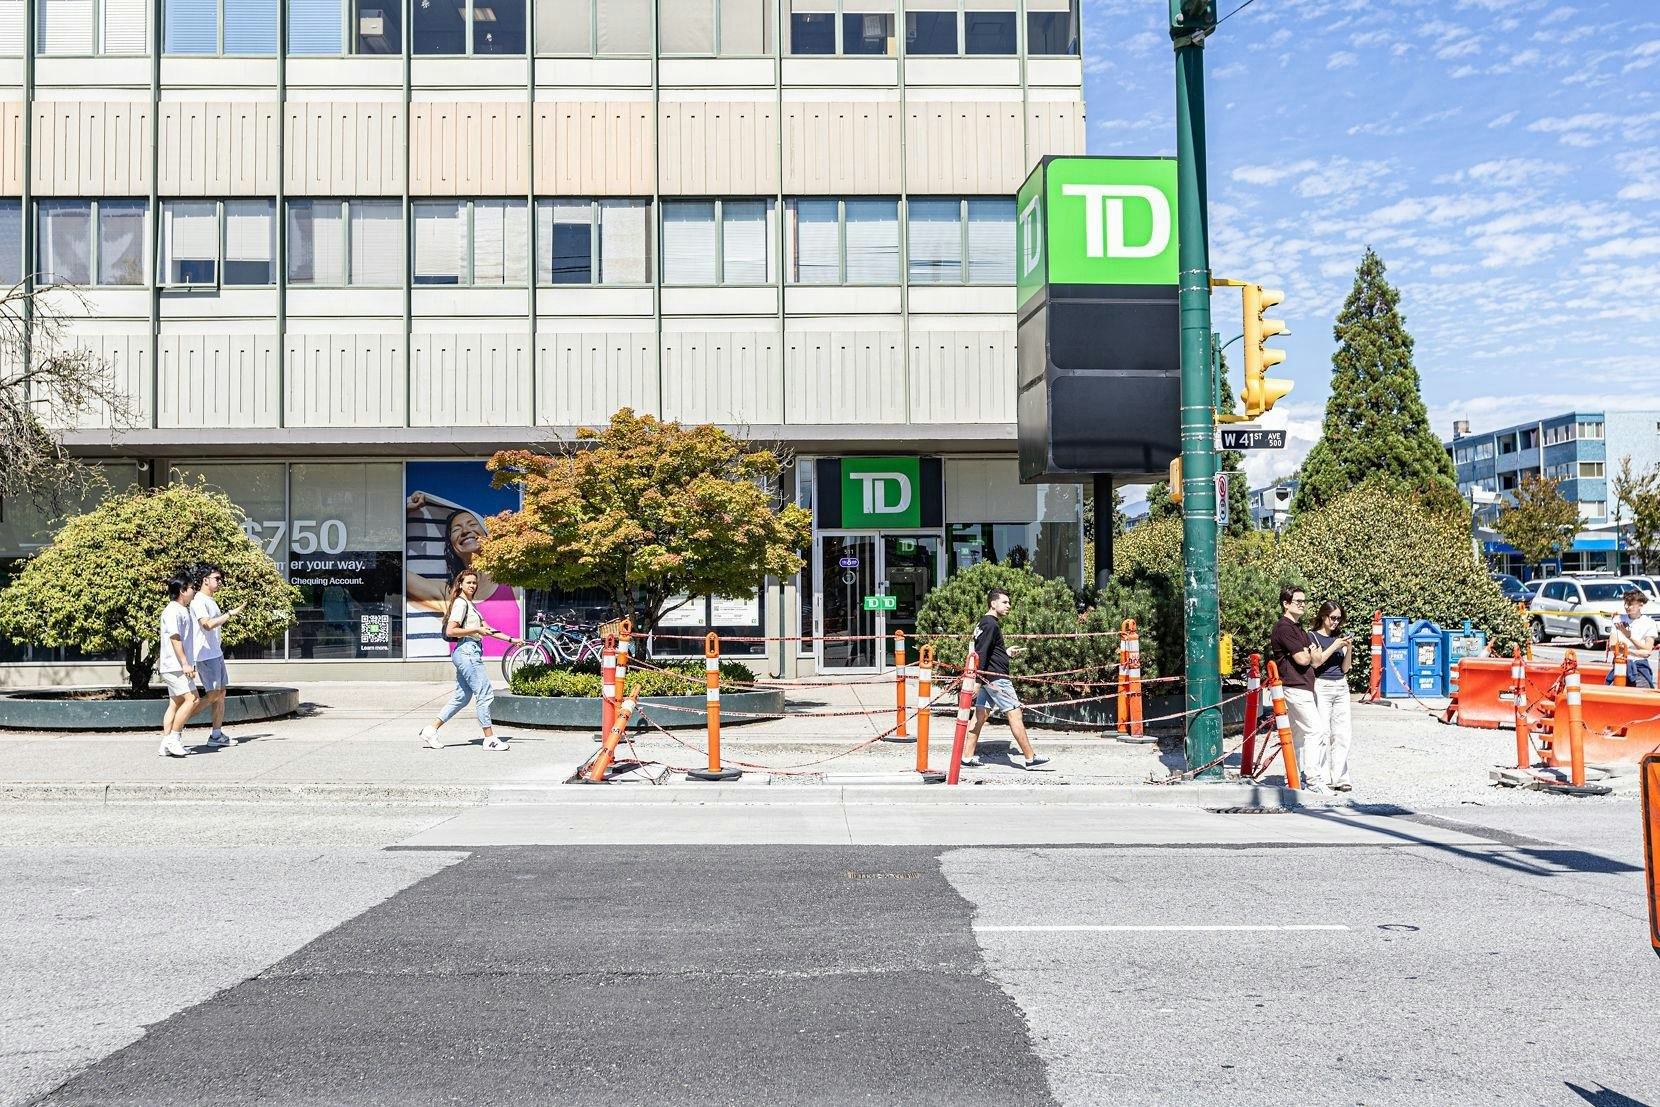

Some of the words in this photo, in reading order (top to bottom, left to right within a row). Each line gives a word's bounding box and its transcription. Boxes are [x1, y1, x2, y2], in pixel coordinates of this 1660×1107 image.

[1062, 183, 1171, 258] TD
[1019, 194, 1041, 278] TD
[1224, 433, 1236, 447] W
[849, 472, 912, 514] TD
[240, 518, 347, 555] $750
[899, 539, 914, 552] TD
[306, 560, 336, 572] your
[337, 560, 366, 572] way.
[291, 577, 328, 587] Chequing
[329, 577, 364, 585] Account.
[866, 598, 878, 608] TD
[883, 598, 894, 608] TD
